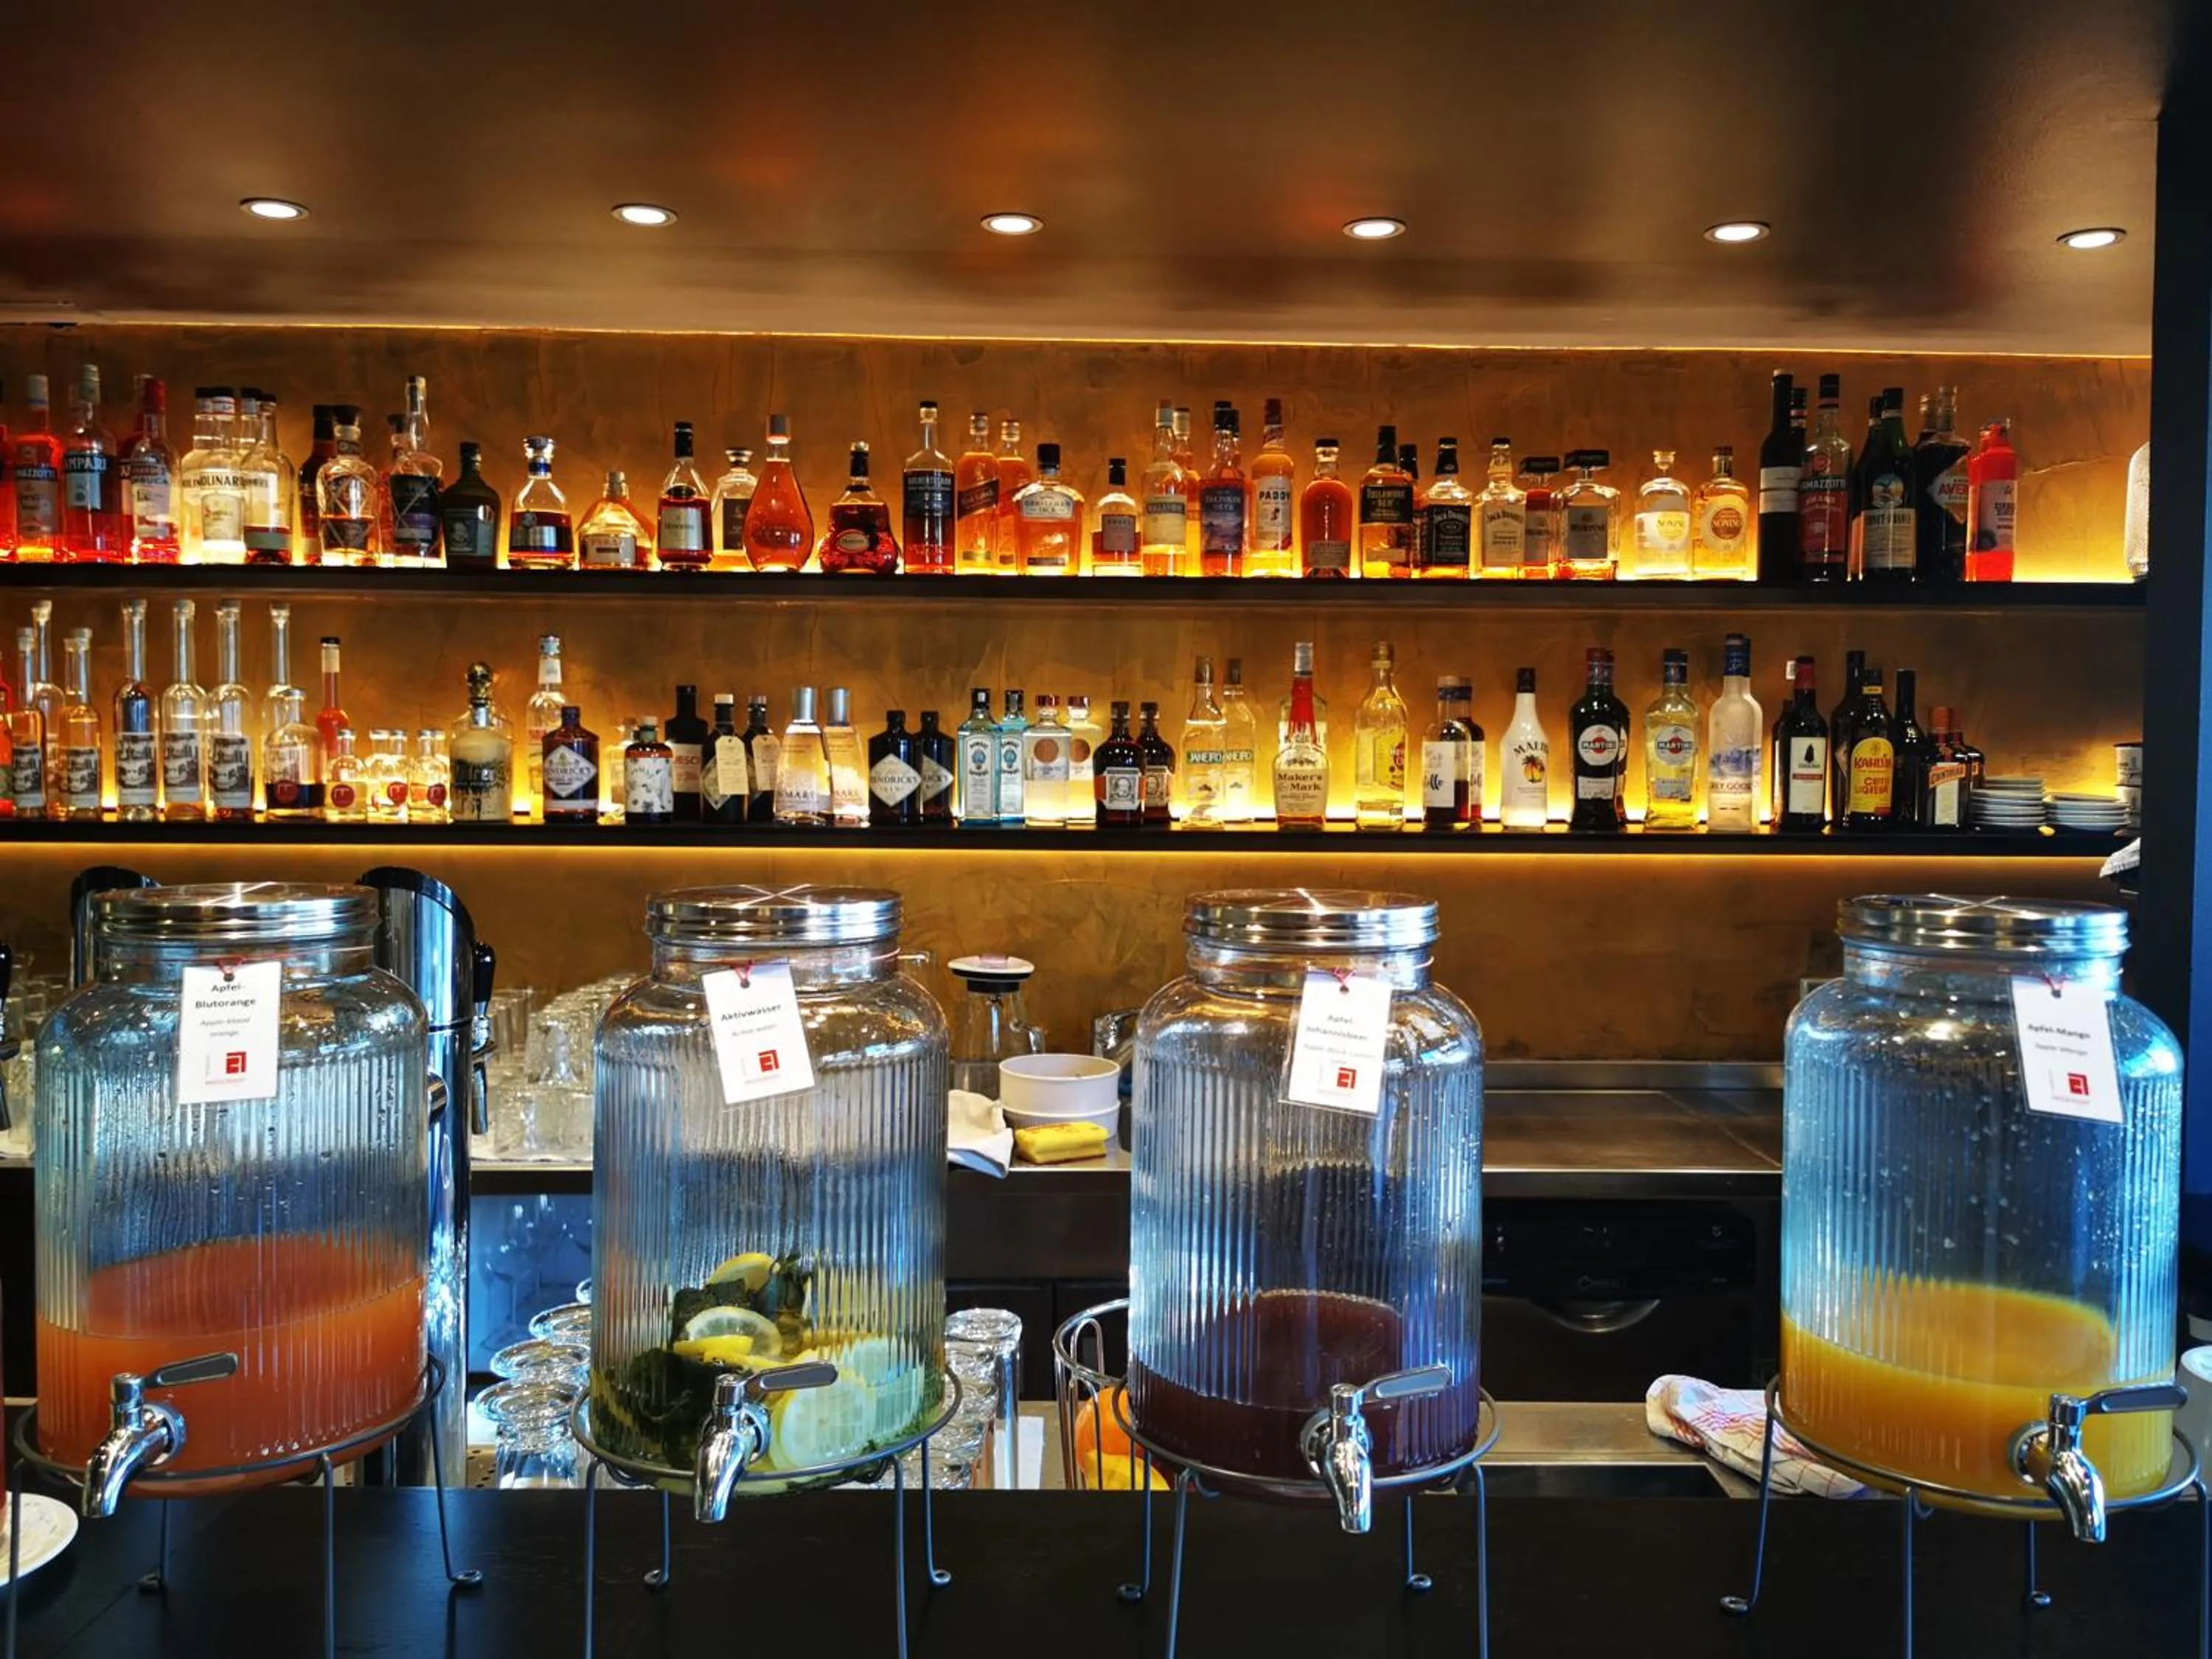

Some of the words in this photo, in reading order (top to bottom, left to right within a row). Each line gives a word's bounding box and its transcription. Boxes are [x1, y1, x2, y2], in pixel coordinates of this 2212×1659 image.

[1259, 491, 1290, 500] PADDY
[1278, 773, 1322, 782] Maker's
[1291, 783, 1321, 791] Mark
[195, 998, 257, 1009] Blutorange
[721, 1004, 782, 1022] Aktivwasser
